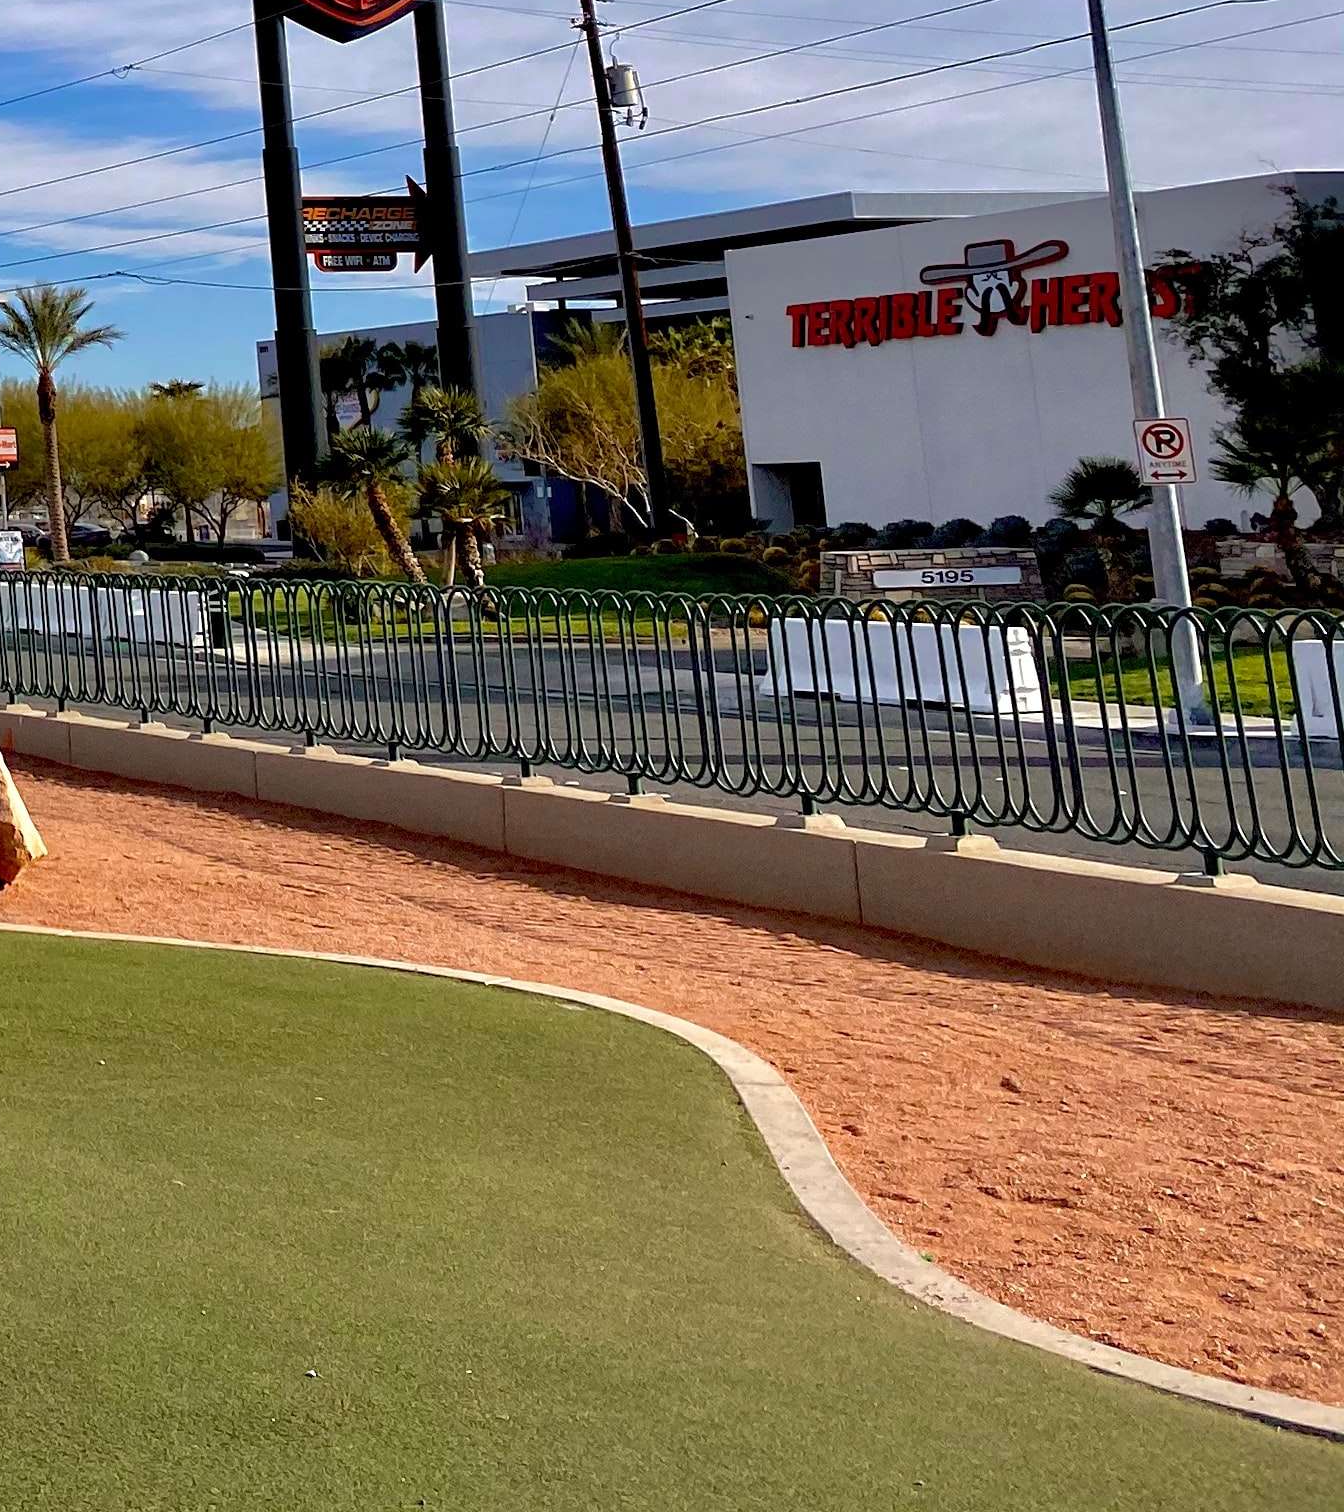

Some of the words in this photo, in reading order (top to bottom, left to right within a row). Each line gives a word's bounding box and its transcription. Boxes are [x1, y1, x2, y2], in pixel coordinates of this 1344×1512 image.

[373, 221, 414, 231] ZONE
[323, 255, 343, 266] FREE
[372, 255, 391, 266] ATM
[785, 287, 963, 348] TERRIBLE
[1030, 263, 1201, 334] HERST
[921, 570, 974, 584] 5195
